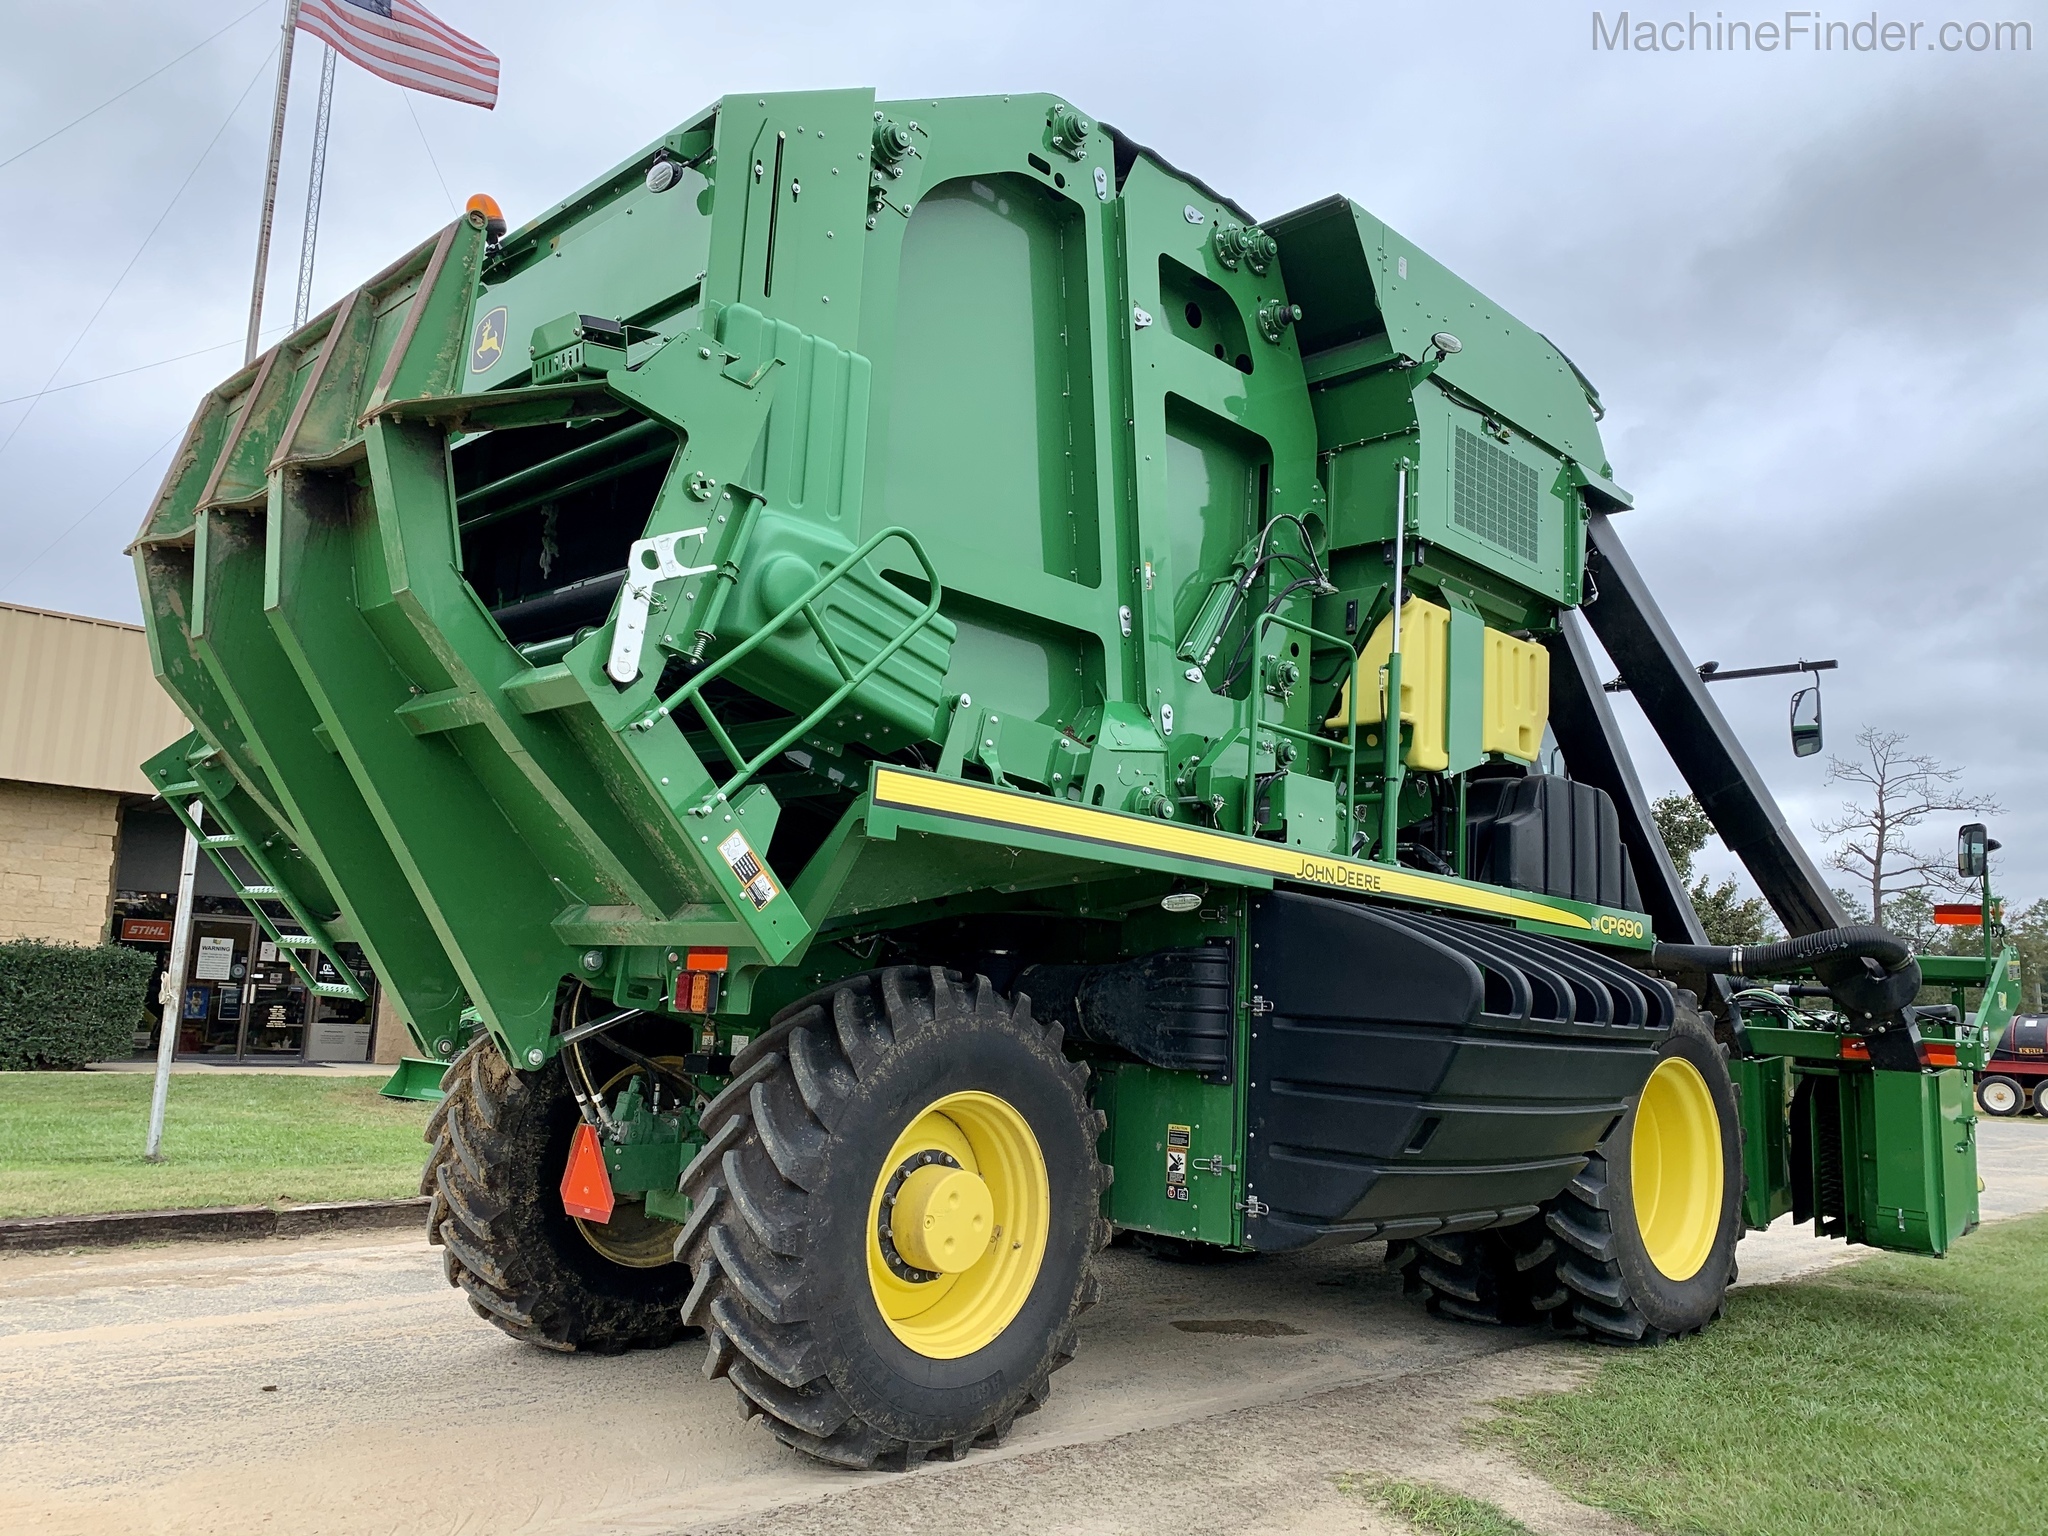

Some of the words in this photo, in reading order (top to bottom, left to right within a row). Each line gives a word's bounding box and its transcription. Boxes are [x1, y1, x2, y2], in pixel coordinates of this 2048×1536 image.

[1296, 858, 1335, 882] JOHN
[1336, 865, 1381, 890] DEERE
[128, 925, 166, 936] STIHL
[1600, 915, 1644, 940] CP690
